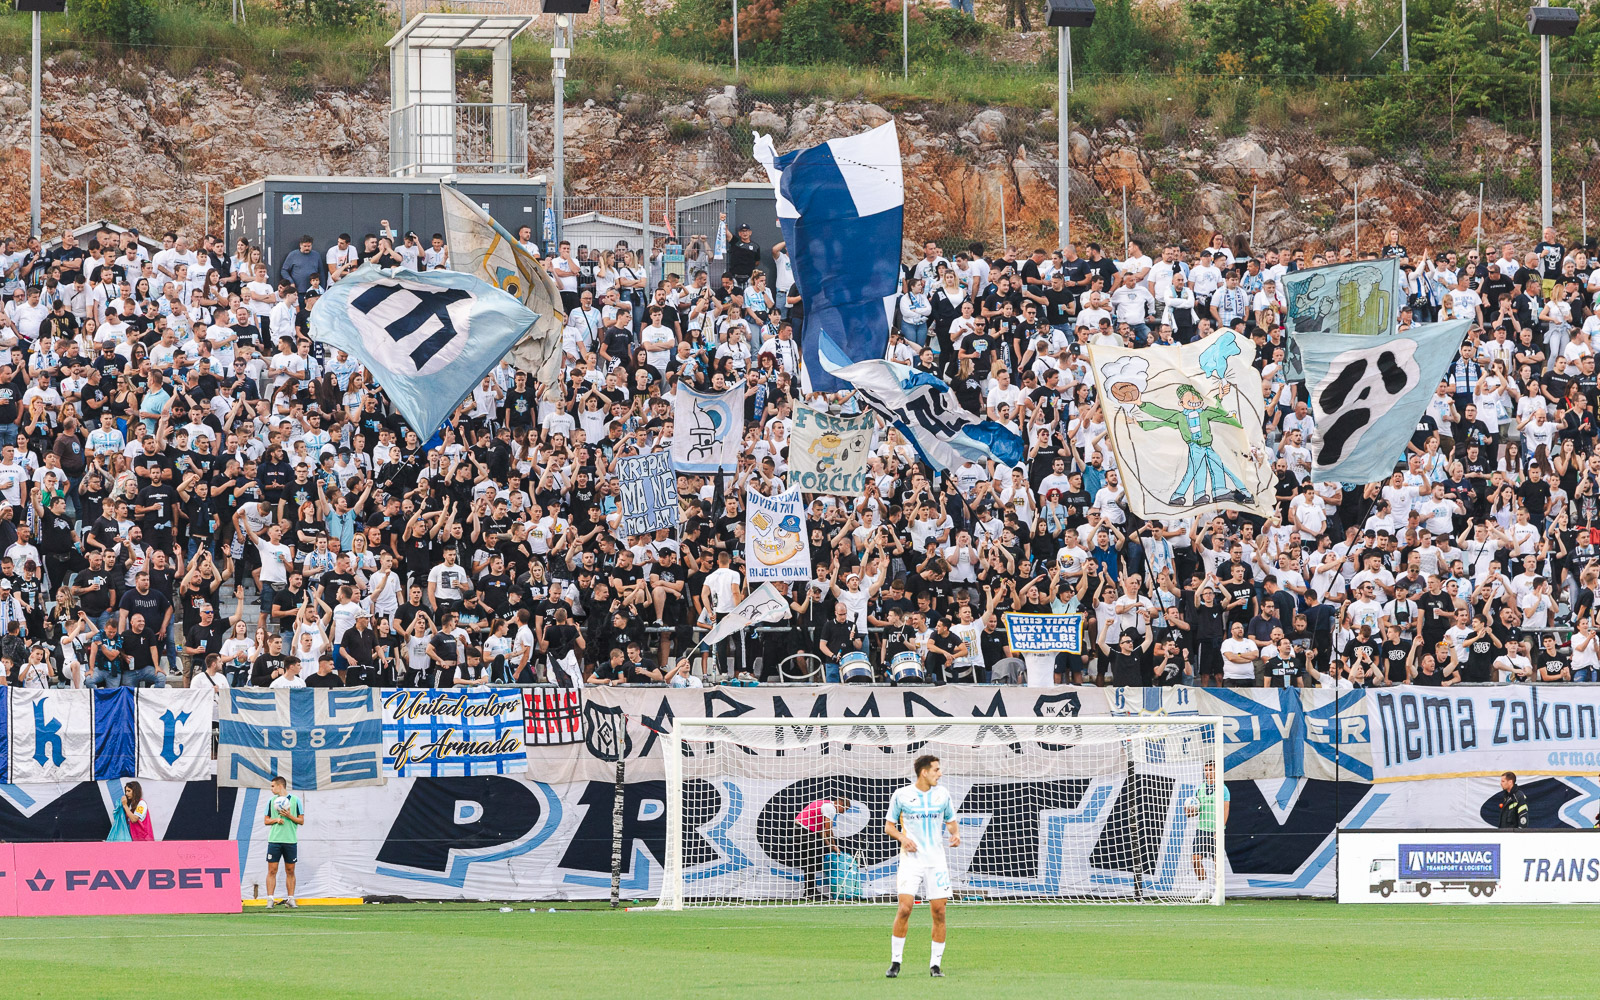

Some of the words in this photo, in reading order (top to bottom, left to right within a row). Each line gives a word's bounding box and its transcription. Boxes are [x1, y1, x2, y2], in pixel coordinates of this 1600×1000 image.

[795, 408, 874, 432] FORZA
[617, 451, 671, 482] KREPAT
[619, 479, 649, 516] MA
[650, 471, 678, 509] NE
[749, 567, 778, 577] RIJECI
[781, 566, 808, 577] ODANI
[1010, 616, 1043, 624] THIS
[1044, 617, 1078, 625] TIME
[888, 633, 908, 643] ICN
[1014, 634, 1056, 642] WE'LL
[1059, 634, 1077, 642] BE
[1014, 641, 1077, 650] CHAMPIONS
[383, 690, 463, 720] United
[464, 693, 521, 718] colors
[638, 690, 1023, 758] ARMADA
[1222, 712, 1368, 745] RIVER
[1376, 693, 1477, 767] nema
[1490, 686, 1600, 745] zakon
[261, 726, 355, 750] 1987
[389, 731, 420, 769] of
[411, 727, 520, 762] Armada
[1425, 851, 1493, 864] MRNJAVAC
[65, 867, 231, 891] FAVBET
